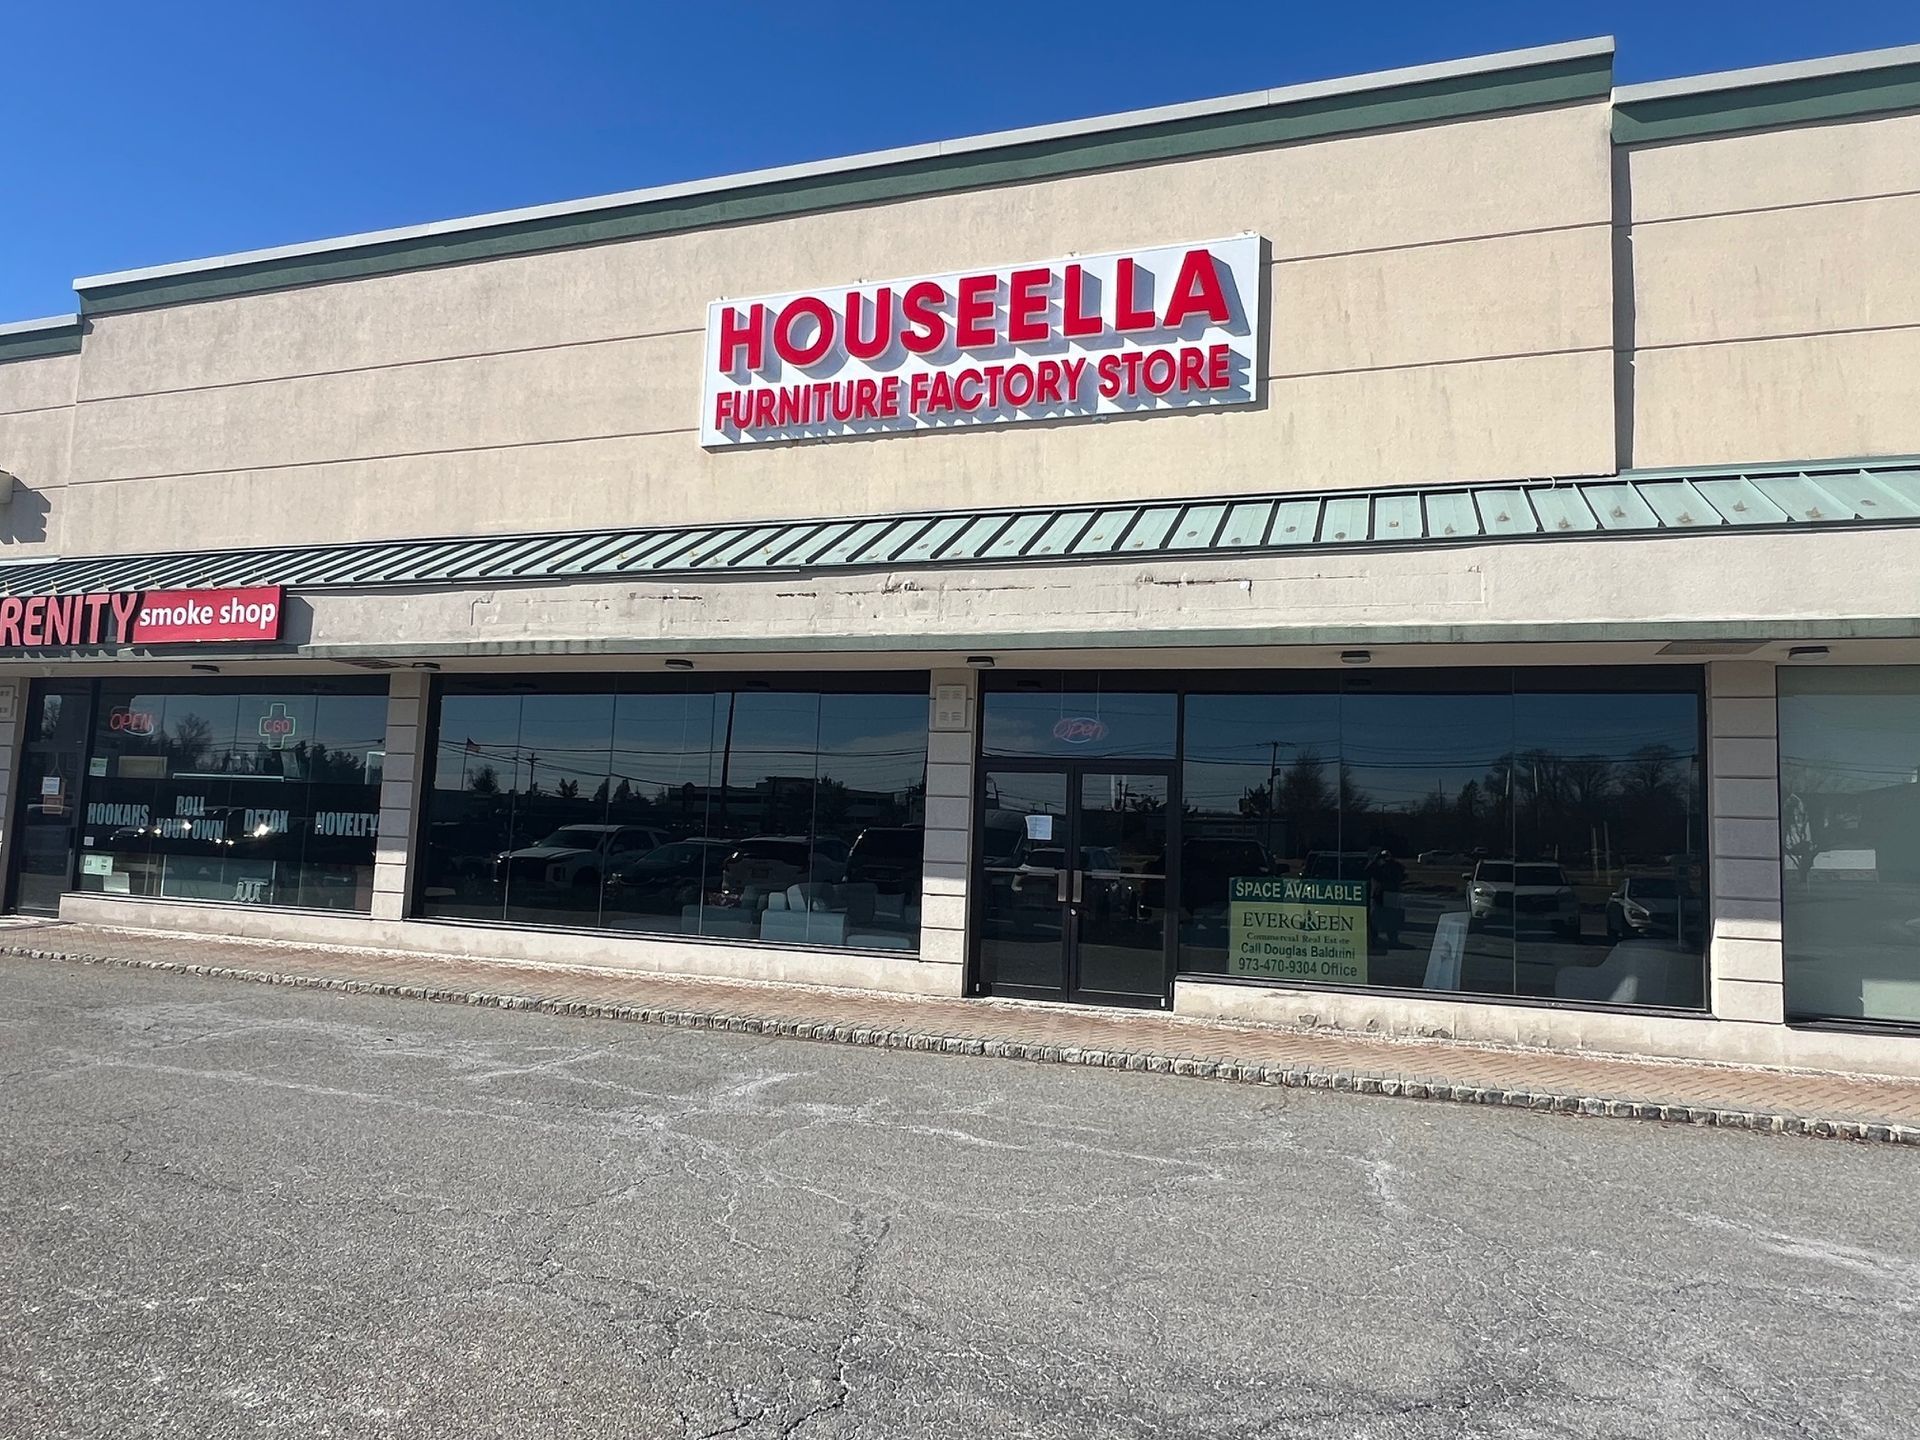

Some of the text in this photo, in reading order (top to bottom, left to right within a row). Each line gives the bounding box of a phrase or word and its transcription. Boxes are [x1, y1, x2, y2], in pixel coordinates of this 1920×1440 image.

[720, 248, 1231, 373] HOUSEELLA
[715, 342, 1231, 431] FURNITURE FACTORY STORE
[0, 592, 138, 646] RENITY
[139, 597, 276, 630] smoke shop
[110, 712, 153, 731] OPEN
[87, 802, 150, 827] HOOKAHS
[175, 795, 206, 817] ROLL
[156, 817, 225, 840] YOUR OWN
[243, 808, 290, 834] DETOX
[314, 811, 379, 837] NOVELTY
[1235, 881, 1362, 901] SPACE AVAILABLE
[1243, 910, 1354, 932] EVERGREEN
[1241, 942, 1261, 955] Call
[1264, 943, 1308, 959] Douglas
[1302, 934, 1321, 944] Real
[1238, 957, 1357, 977] 973-470-9304 Office
